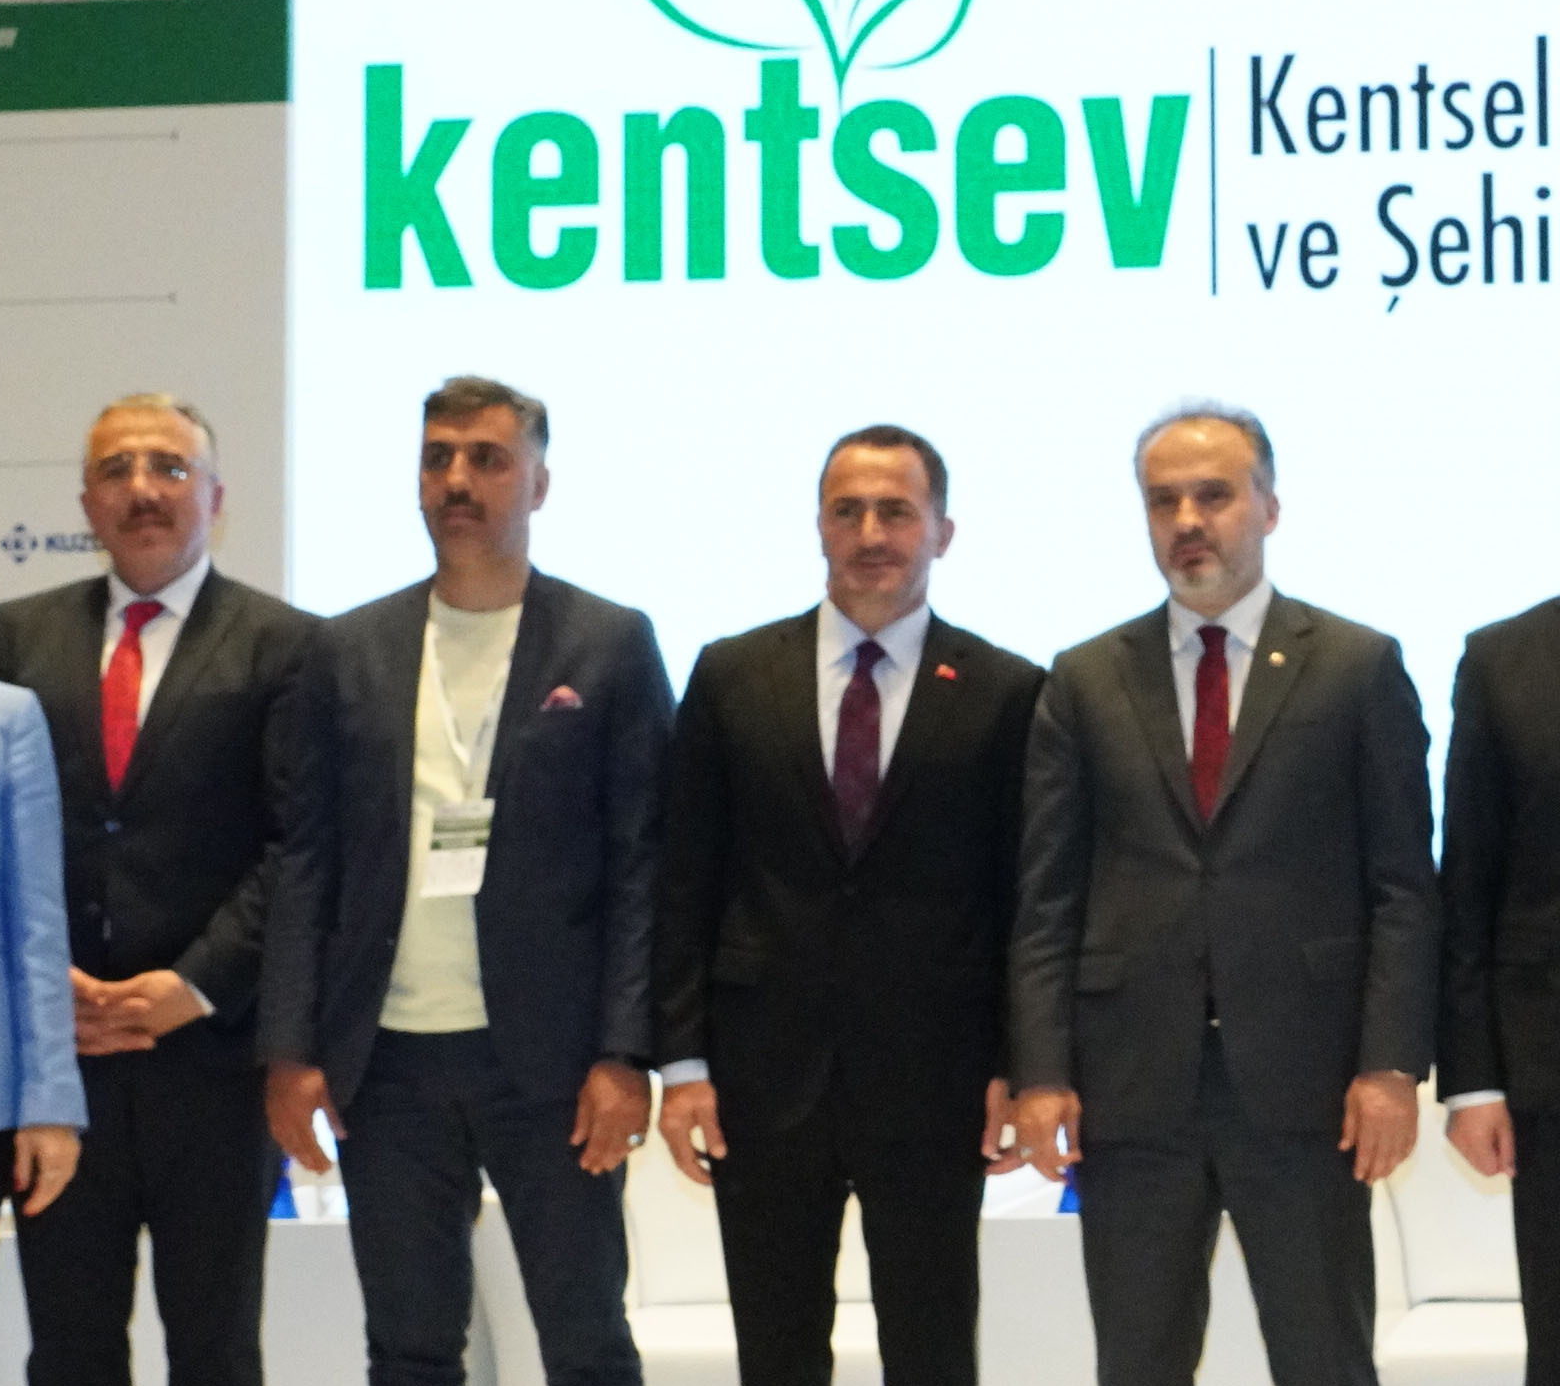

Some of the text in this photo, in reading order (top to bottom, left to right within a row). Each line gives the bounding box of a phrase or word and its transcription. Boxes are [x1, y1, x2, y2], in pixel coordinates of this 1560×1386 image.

[1250, 35, 1550, 156] Kentsel
[364, 59, 1192, 291] kentsev
[1247, 220, 1340, 291] ve
